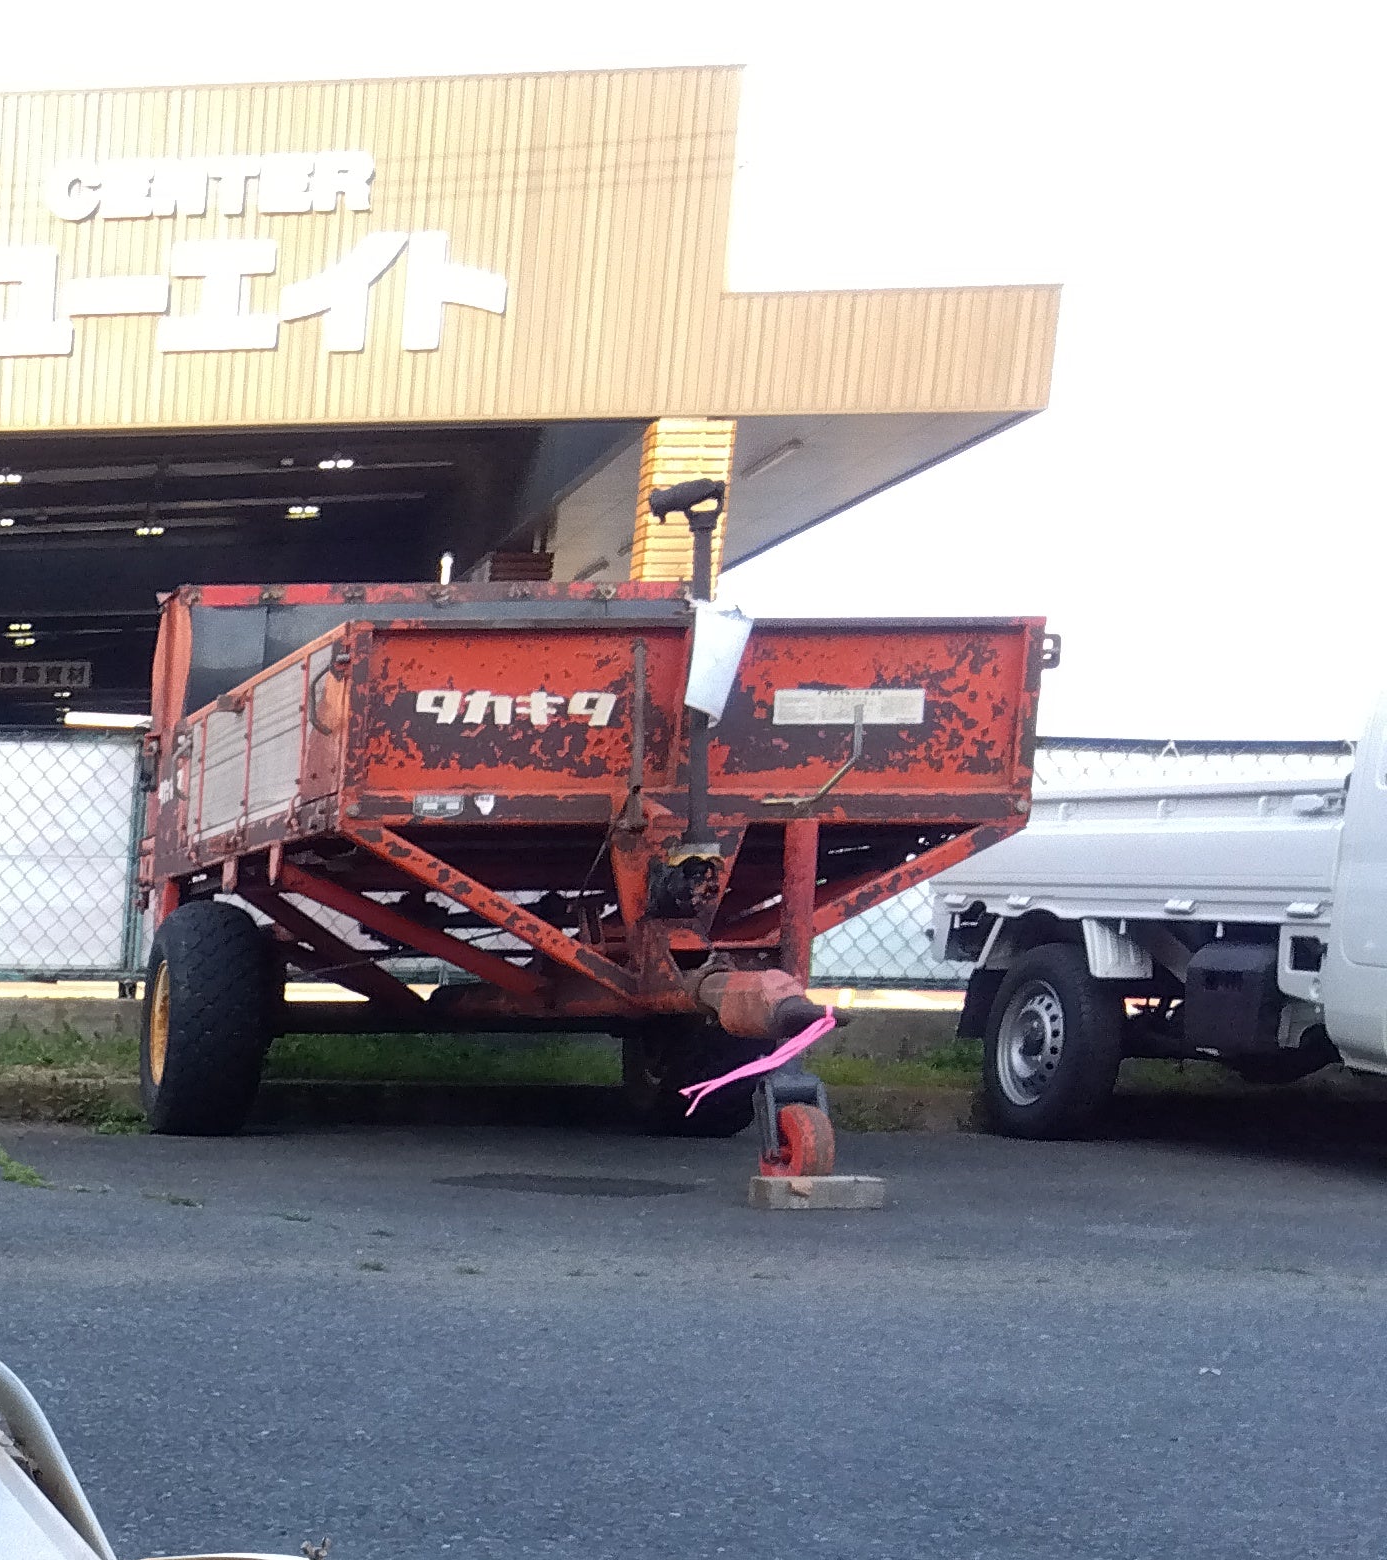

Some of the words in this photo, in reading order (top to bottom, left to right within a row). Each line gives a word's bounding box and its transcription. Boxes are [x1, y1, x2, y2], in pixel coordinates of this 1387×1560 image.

[47, 151, 375, 222] CENTER
[416, 690, 617, 727] タカキタ
